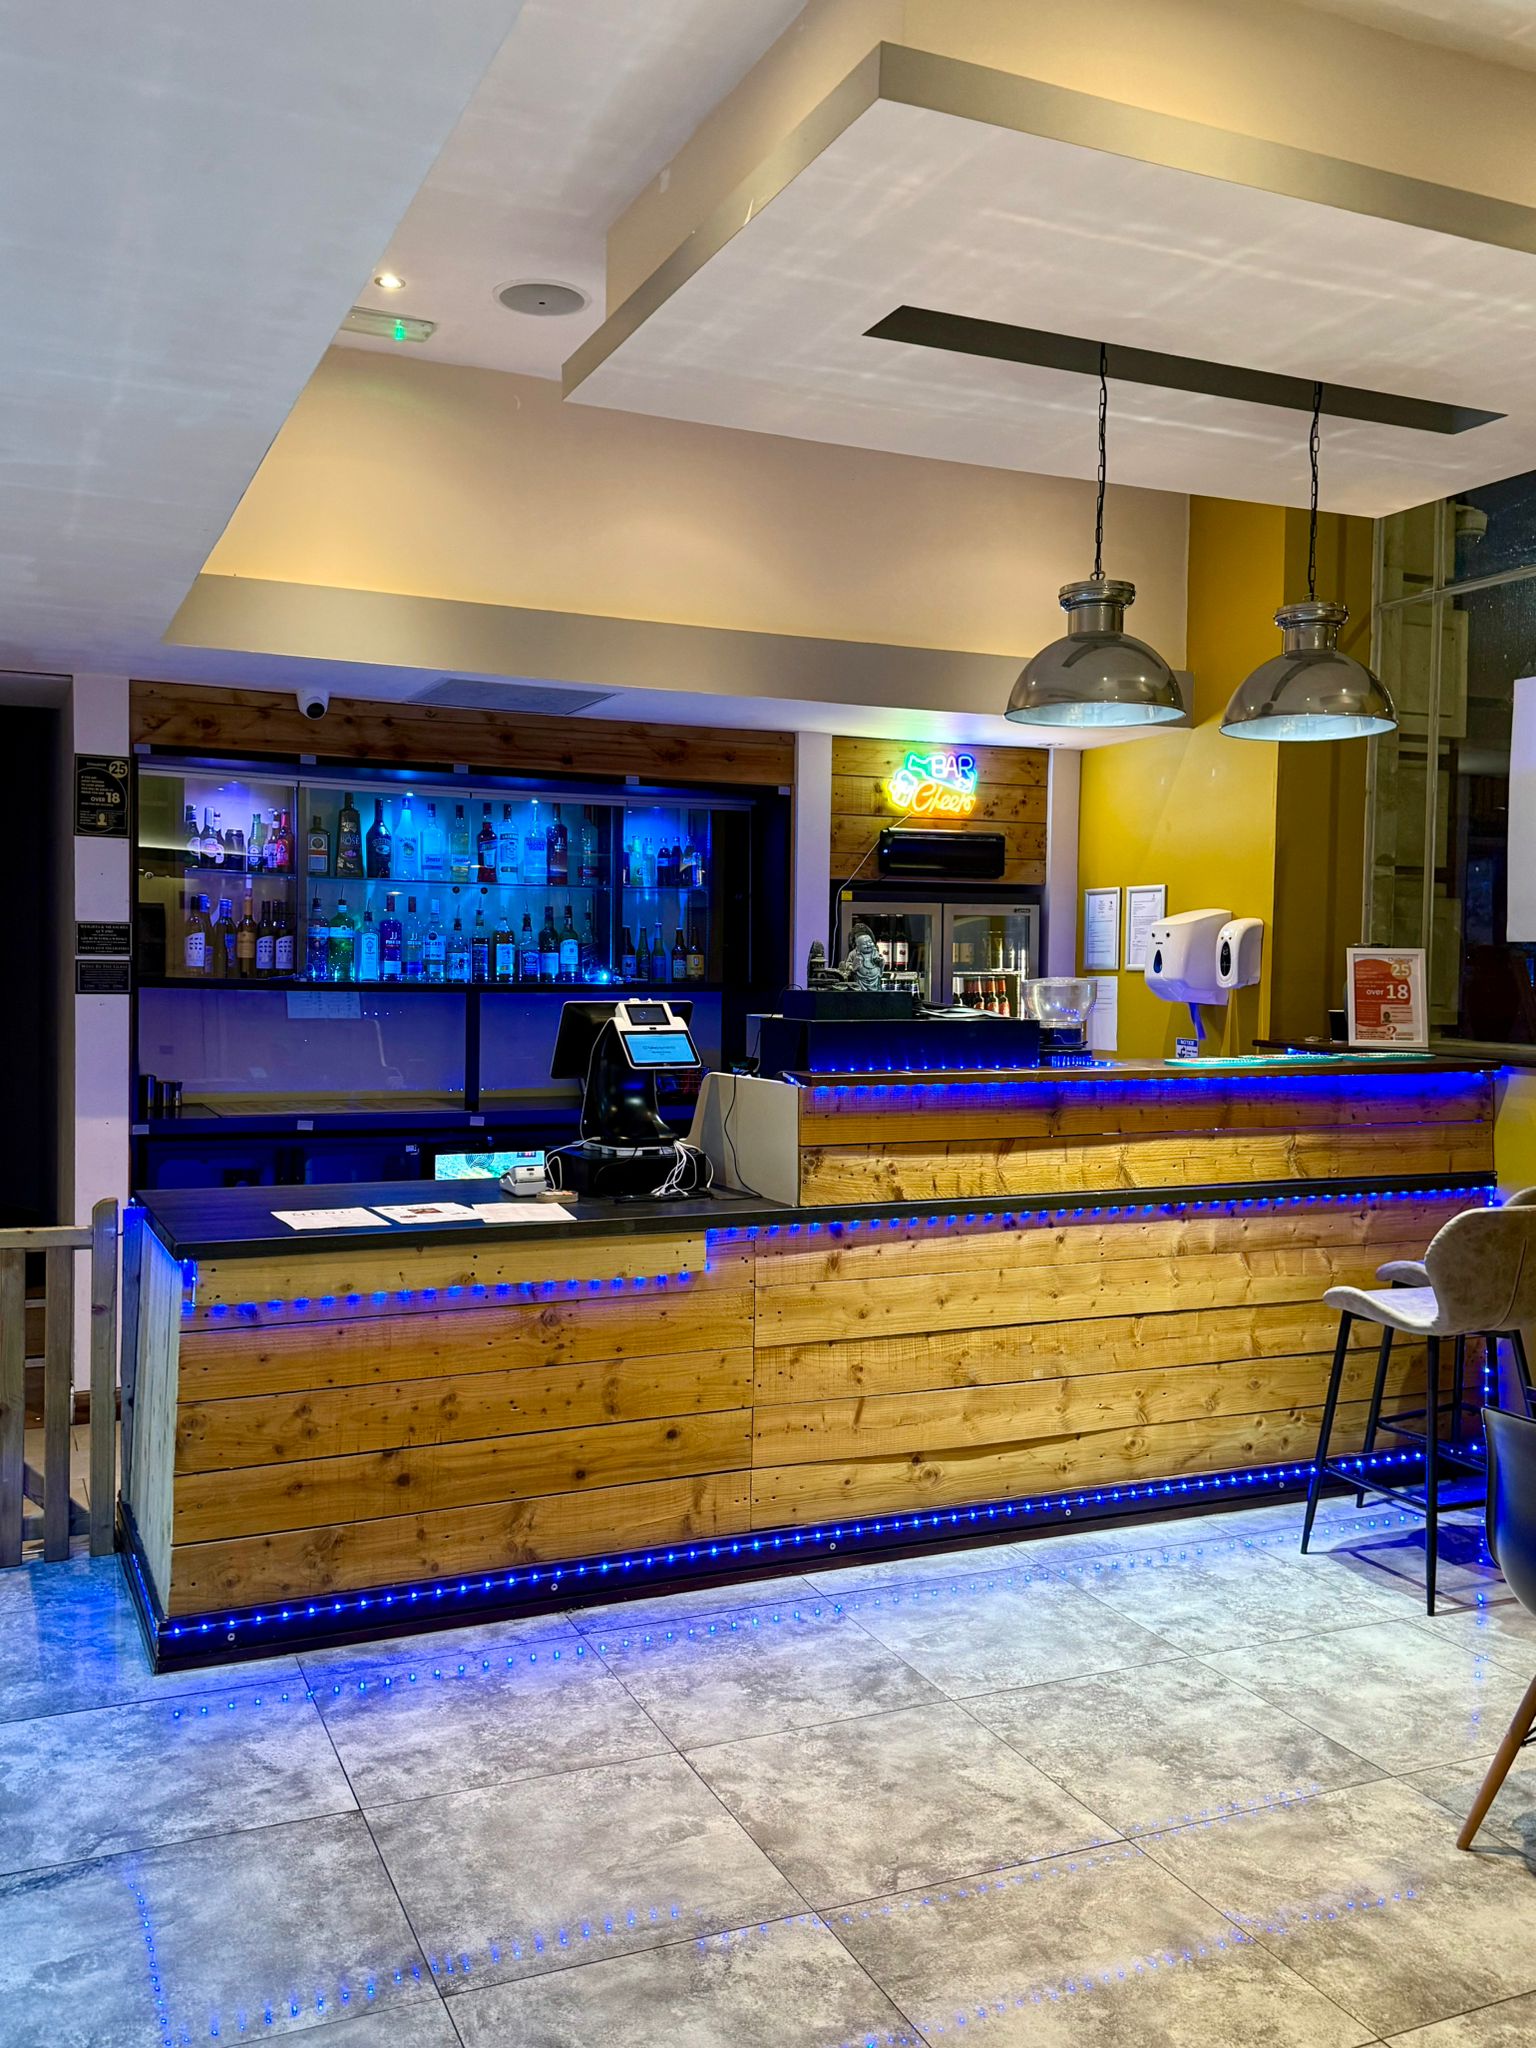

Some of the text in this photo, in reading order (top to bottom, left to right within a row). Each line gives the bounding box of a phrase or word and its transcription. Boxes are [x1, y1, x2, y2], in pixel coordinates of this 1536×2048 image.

[111, 763, 126, 775] 25
[931, 754, 973, 779] BAR
[105, 792, 120, 804] 18
[912, 783, 976, 813] Cheers
[1392, 964, 1410, 976] 25
[1386, 984, 1408, 999] 18
